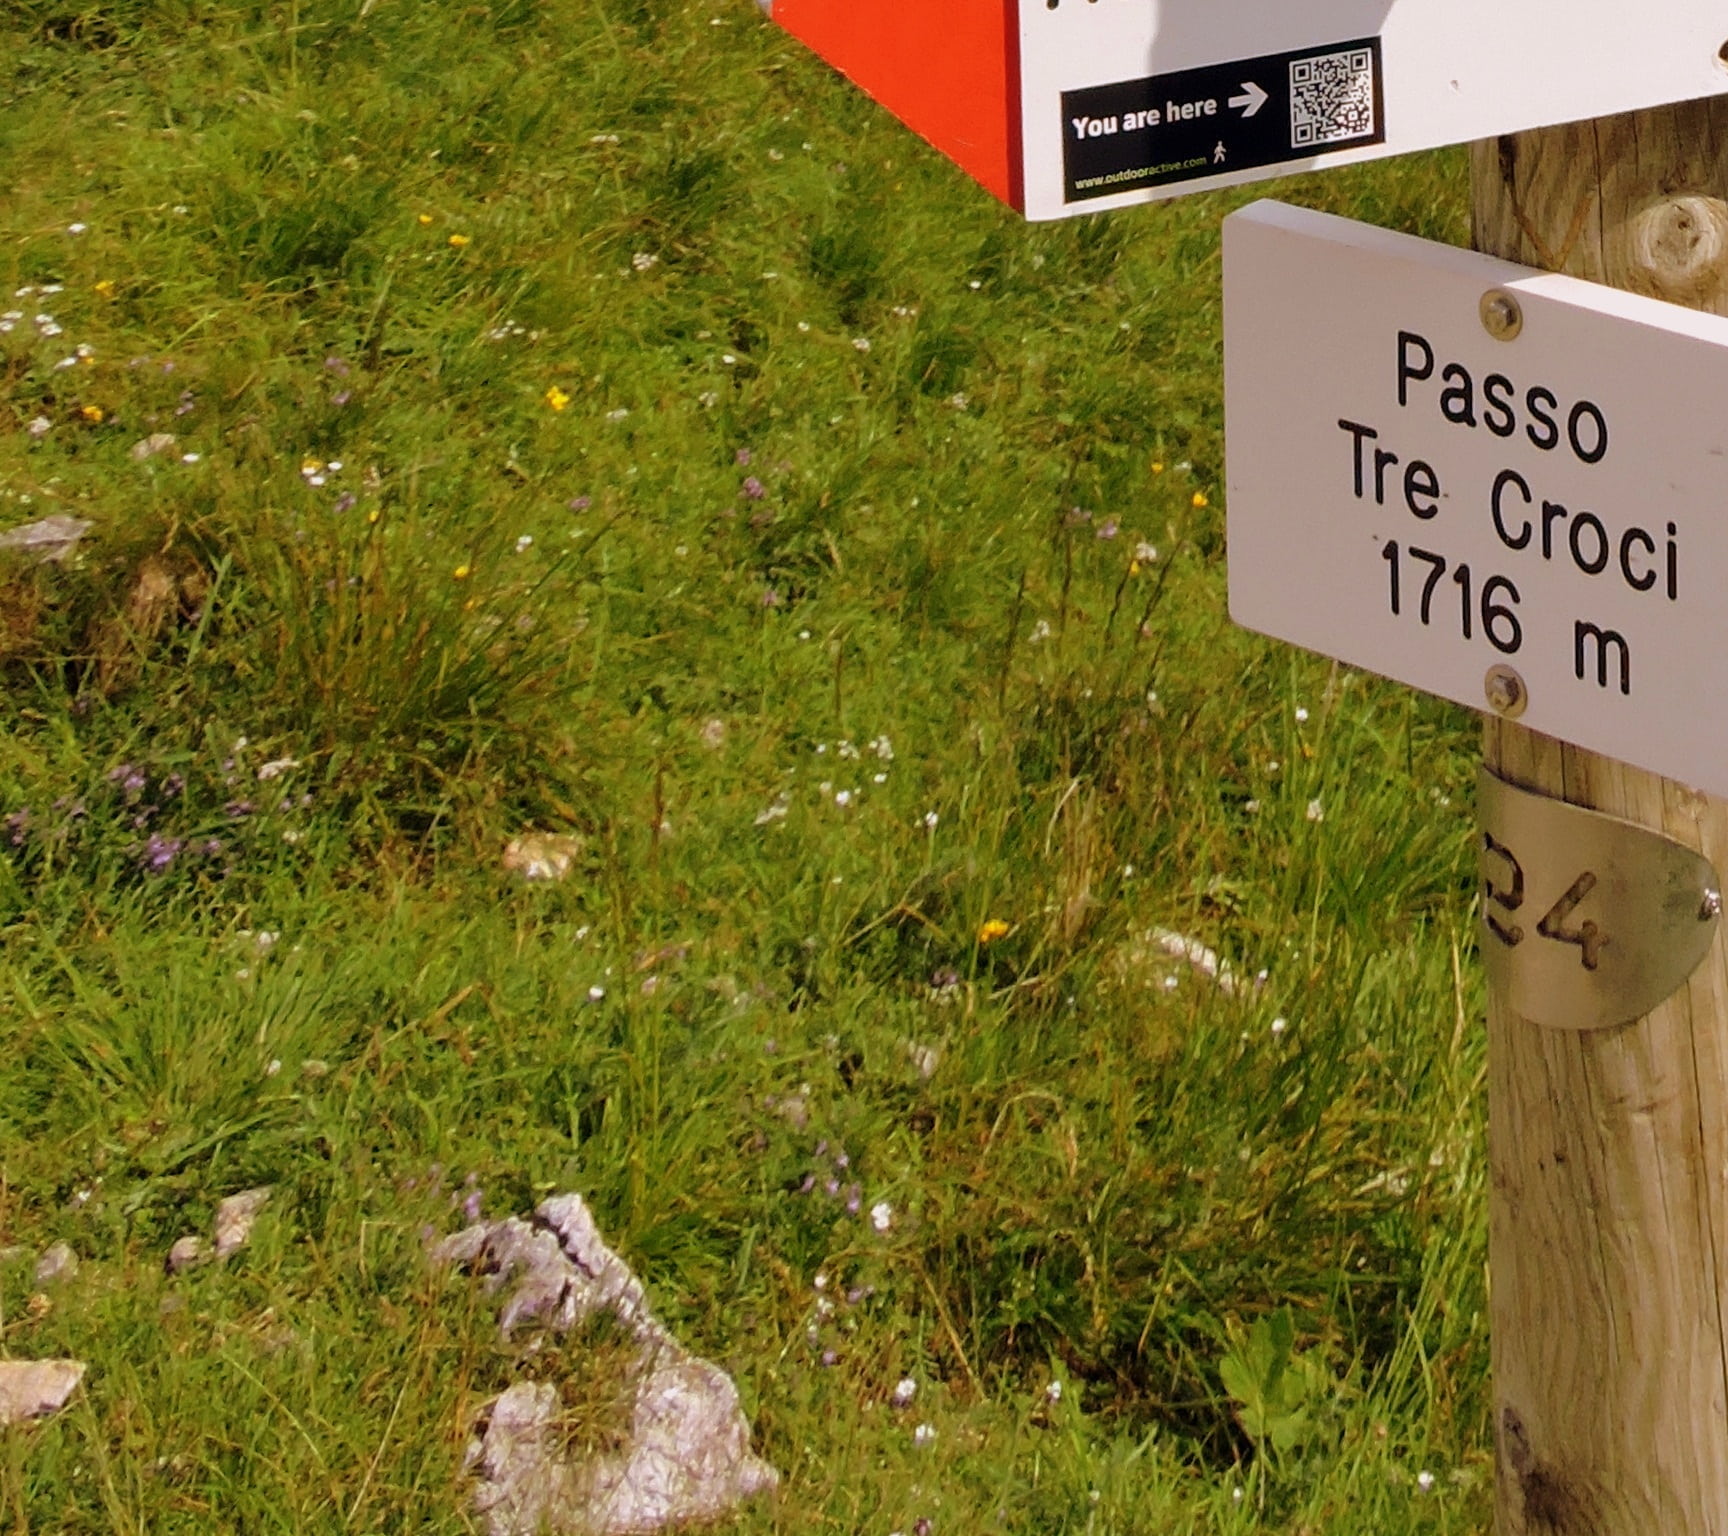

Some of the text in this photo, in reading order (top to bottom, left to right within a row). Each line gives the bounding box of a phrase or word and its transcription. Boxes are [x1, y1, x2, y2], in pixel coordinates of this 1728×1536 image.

[1072, 98, 1217, 140] You are here
[1074, 157, 1207, 190] www.outdooractive.com
[1398, 329, 1608, 464] Passo
[1338, 419, 1680, 601] Tre Croci
[1382, 538, 1630, 695] 1716 m
